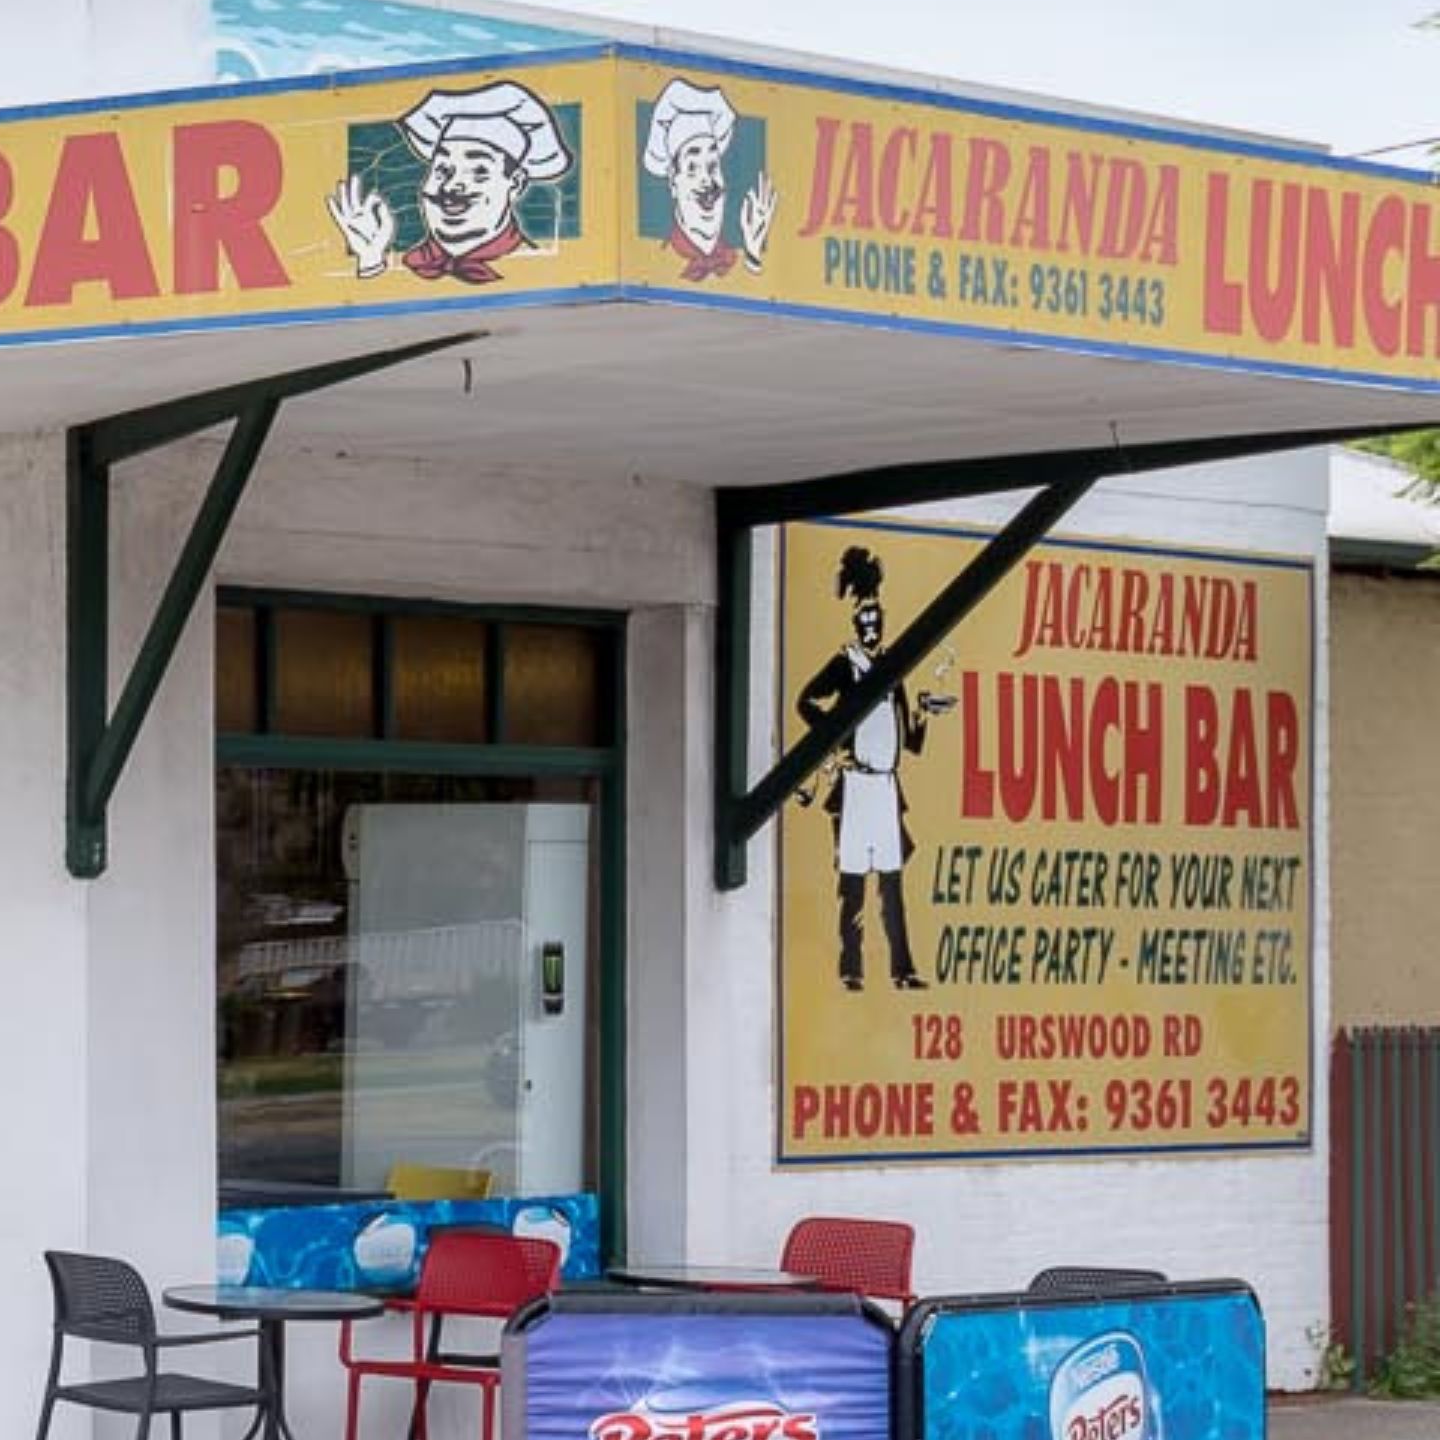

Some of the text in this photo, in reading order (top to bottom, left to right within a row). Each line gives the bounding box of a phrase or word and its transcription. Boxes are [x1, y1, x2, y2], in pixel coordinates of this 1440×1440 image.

[797, 116, 1180, 265] JACARANDA
[824, 236, 1165, 327] PHONE & FAX: 9361 3443
[1203, 172, 1440, 358] LUNCH
[1013, 560, 1258, 662] JACARANDA
[961, 671, 1300, 829] LUNCH BAR
[932, 845, 1301, 910] LET US CATER FOR YOUR NEXT
[936, 924, 1026, 984] OFFICE
[1031, 927, 1115, 984] PARTY
[1137, 929, 1246, 984] MEETING
[1252, 929, 1297, 984] ETC.
[912, 1014, 1202, 1060] 128 URSWOOD RD
[792, 1076, 1300, 1139] PHONE & FAX: 9361 3443
